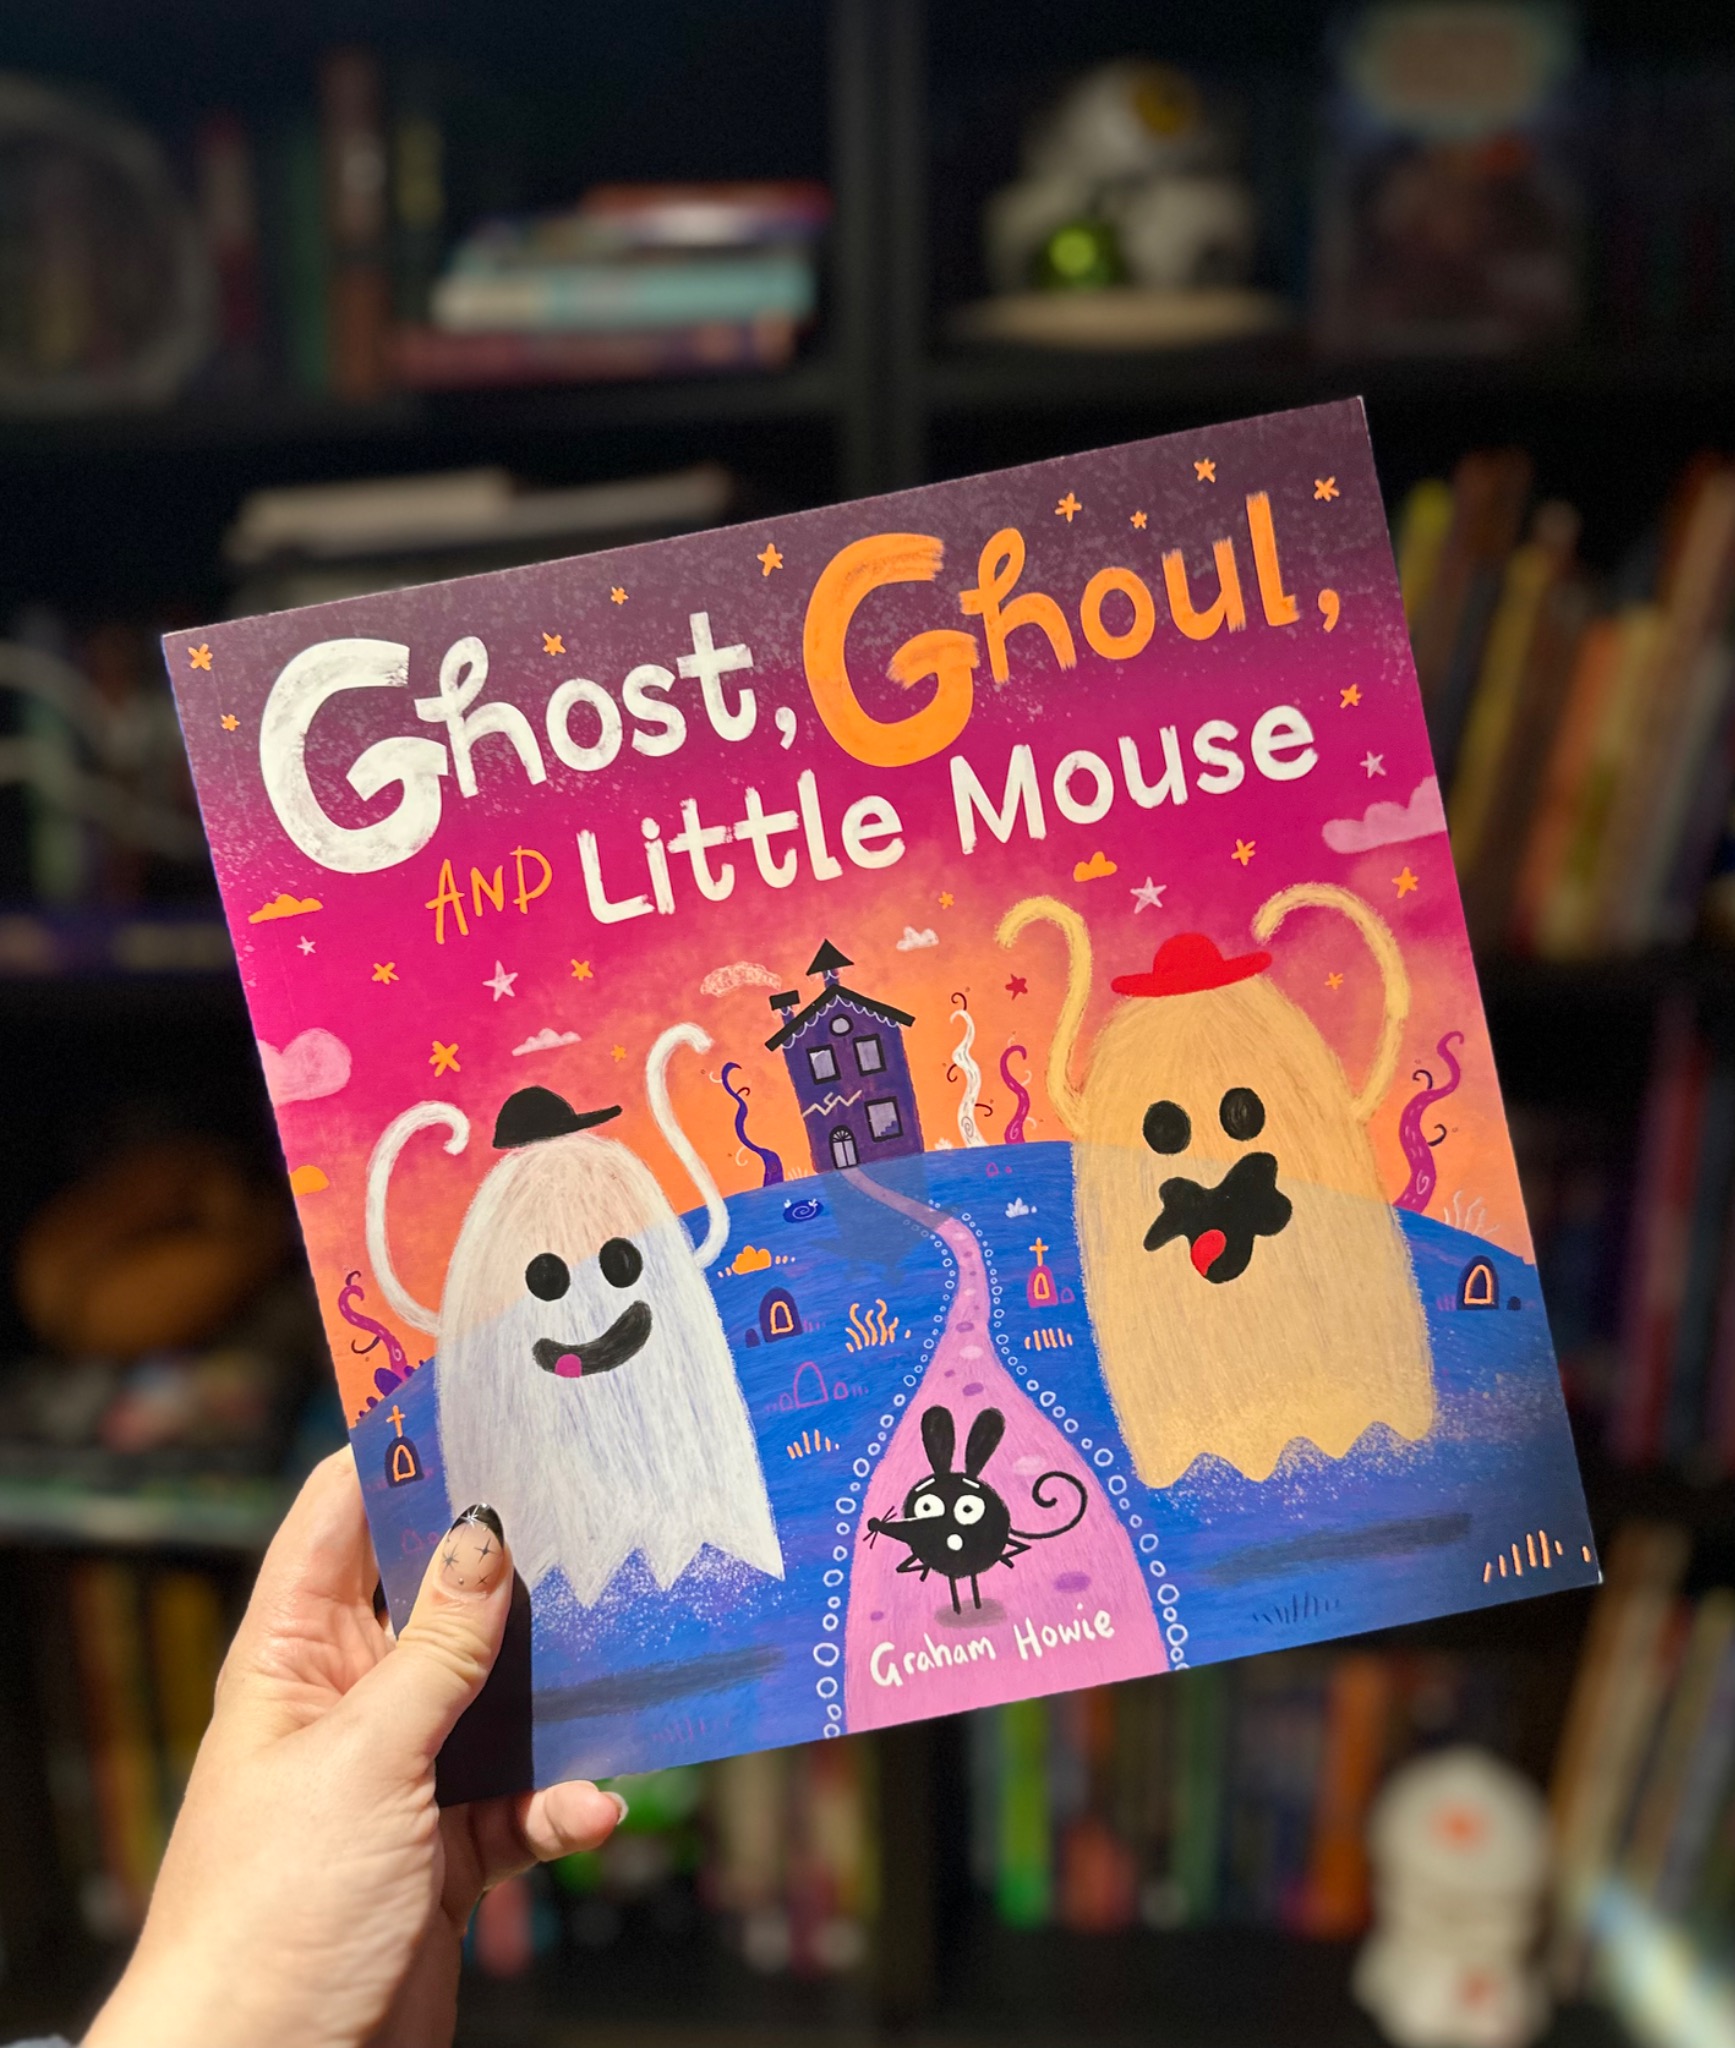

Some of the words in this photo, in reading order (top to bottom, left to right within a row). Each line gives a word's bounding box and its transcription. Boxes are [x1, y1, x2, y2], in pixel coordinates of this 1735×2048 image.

[259, 611, 797, 875] Ghost,
[803, 490, 1341, 768] Ghoul,
[425, 845, 553, 945] AND
[576, 768, 906, 925] Little
[950, 705, 1319, 855] Mouse
[869, 1632, 997, 1687] Graham
[1013, 1602, 1115, 1661] Howie
